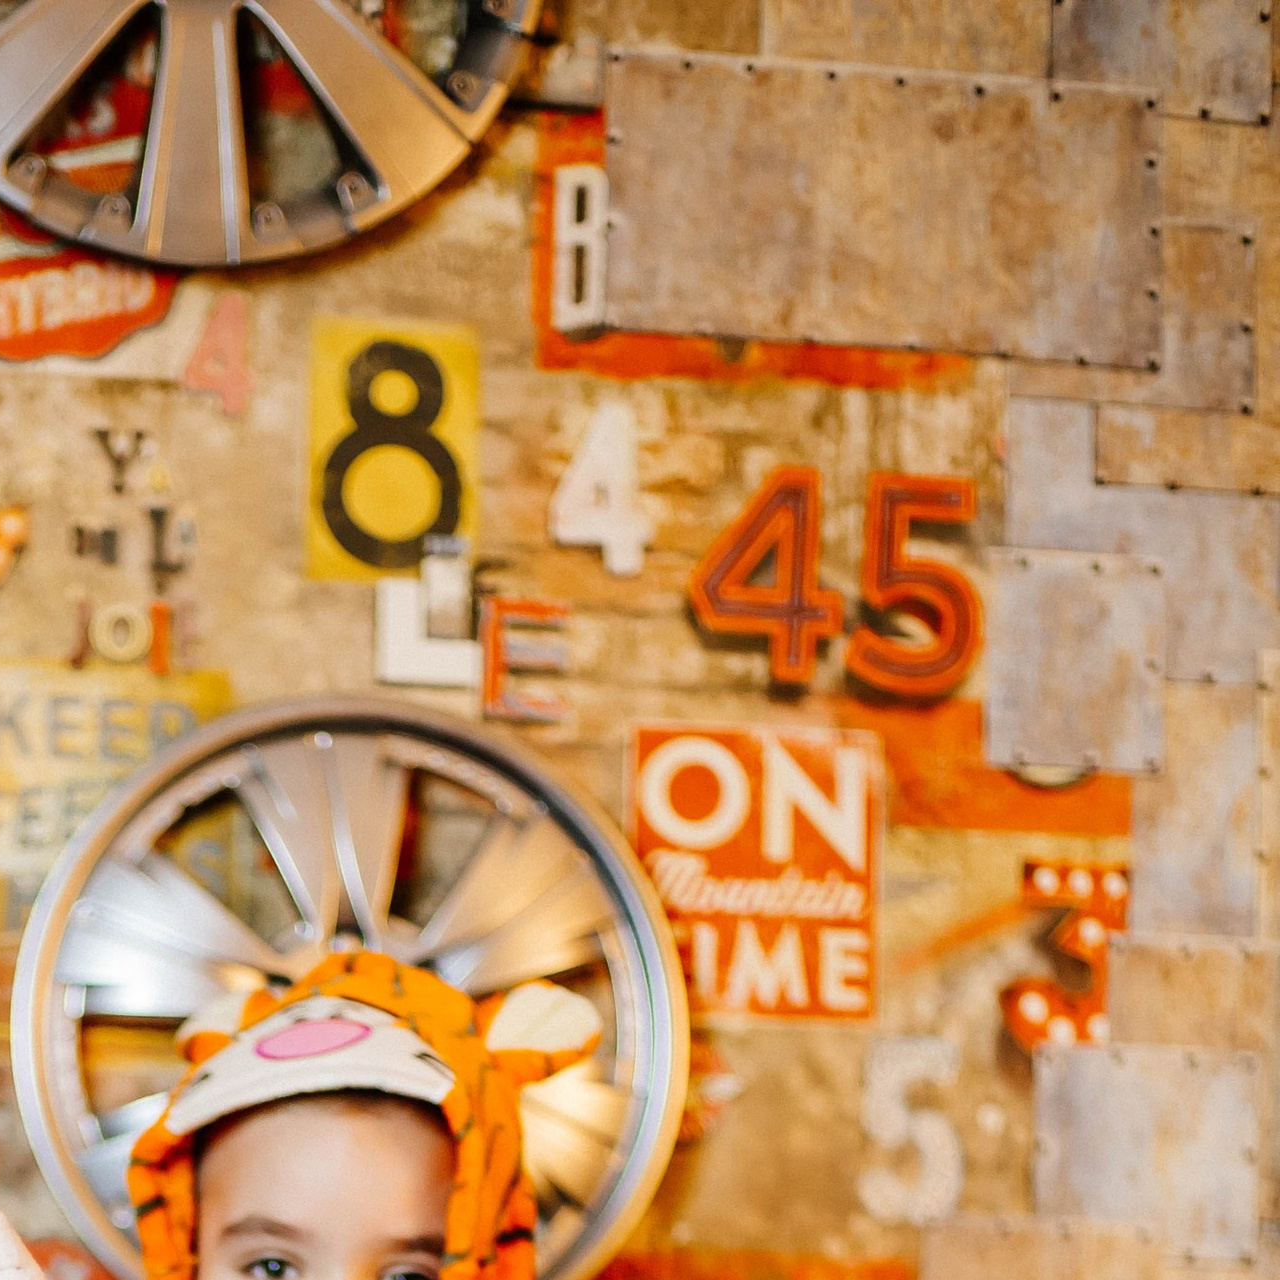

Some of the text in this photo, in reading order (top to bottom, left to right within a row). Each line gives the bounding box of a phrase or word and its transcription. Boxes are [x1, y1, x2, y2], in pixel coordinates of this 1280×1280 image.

[322, 340, 462, 568] 8
[548, 400, 654, 578] 4
[686, 464, 986, 700] 45
[638, 733, 868, 874] ON
[688, 916, 871, 1014] IME
[858, 1038, 966, 1224] 5
